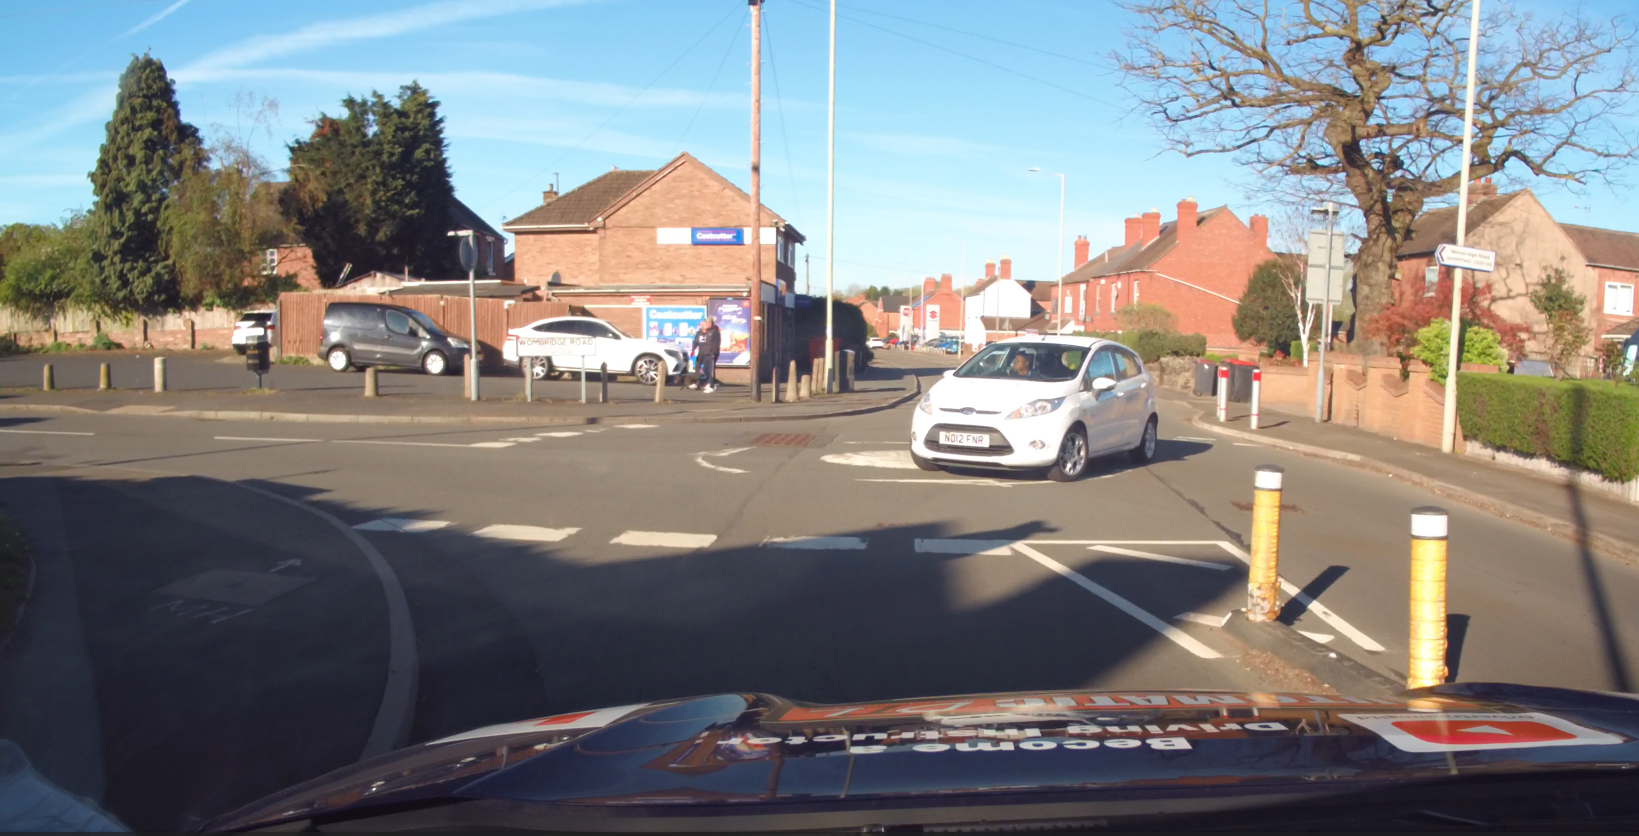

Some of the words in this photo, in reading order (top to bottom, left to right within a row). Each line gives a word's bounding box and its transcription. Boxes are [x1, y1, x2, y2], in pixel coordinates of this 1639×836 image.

[519, 338, 567, 346] WOMBRIDGE
[569, 338, 594, 346] ROAD
[944, 434, 964, 443] ND12
[966, 435, 984, 444] FNR
[1066, 721, 1289, 734] Driving
[716, 728, 1042, 746] Instructor
[849, 744, 888, 754] a
[912, 737, 1193, 752] Become
